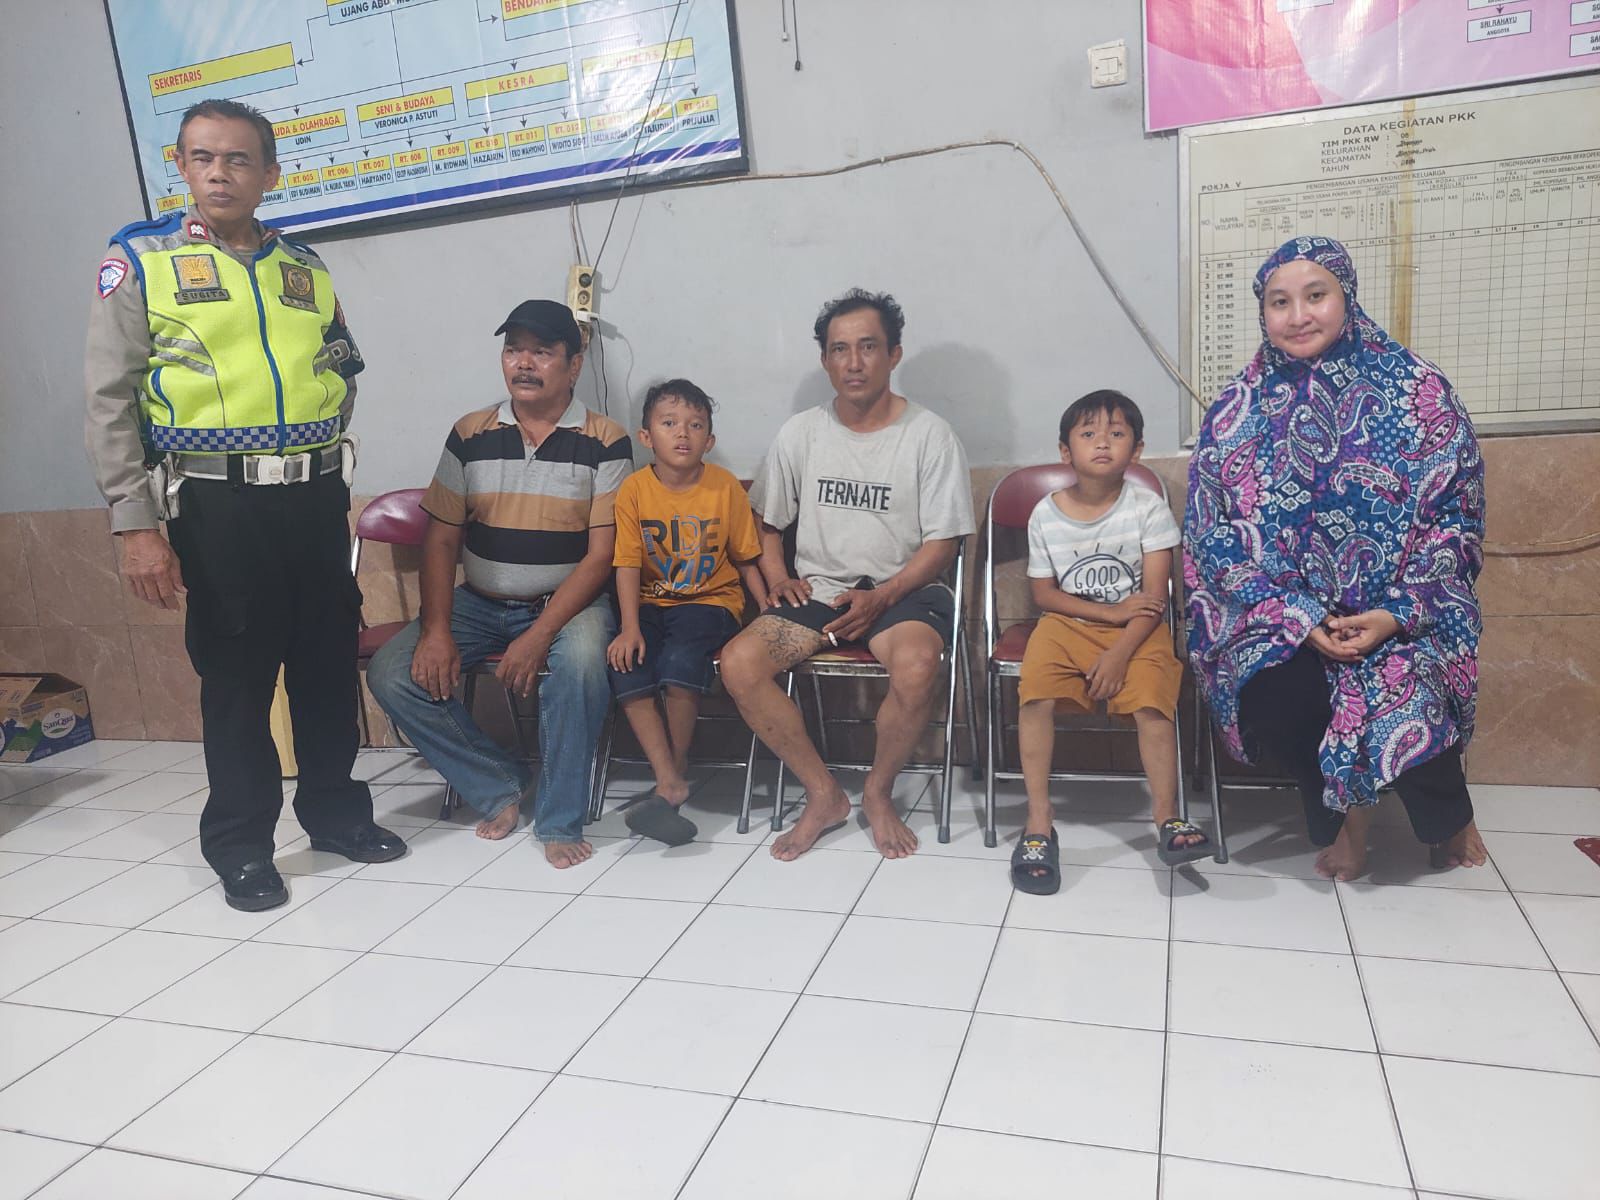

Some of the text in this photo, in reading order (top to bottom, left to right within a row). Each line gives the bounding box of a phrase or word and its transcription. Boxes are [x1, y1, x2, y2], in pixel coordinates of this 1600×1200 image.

[340, 2, 369, 17] UJANG
[504, 0, 560, 12] BENDA
[154, 69, 202, 90] SEKRETARIS
[498, 74, 535, 91] KESRA
[376, 95, 435, 116] SENI & BUDAYA
[275, 115, 341, 137] UDA & OLAHRAGA
[374, 115, 408, 129] VERONICA
[415, 109, 438, 121] ASTUTI
[1343, 111, 1476, 135] DATA KEGIATAN PKK
[295, 135, 312, 145] UDIN
[1321, 135, 1380, 148] TIM PKK RW
[1321, 144, 1371, 156] KELURAHAN
[1321, 153, 1371, 165] KECAMATAN
[1321, 164, 1350, 174] TAHUN
[1412, 169, 1446, 179] KELUARGA
[1201, 183, 1230, 192] POKJA
[181, 290, 226, 301] SUGITA
[817, 478, 892, 511] TERNATE
[640, 514, 721, 557] RIDE
[1074, 565, 1120, 590] GOOD
